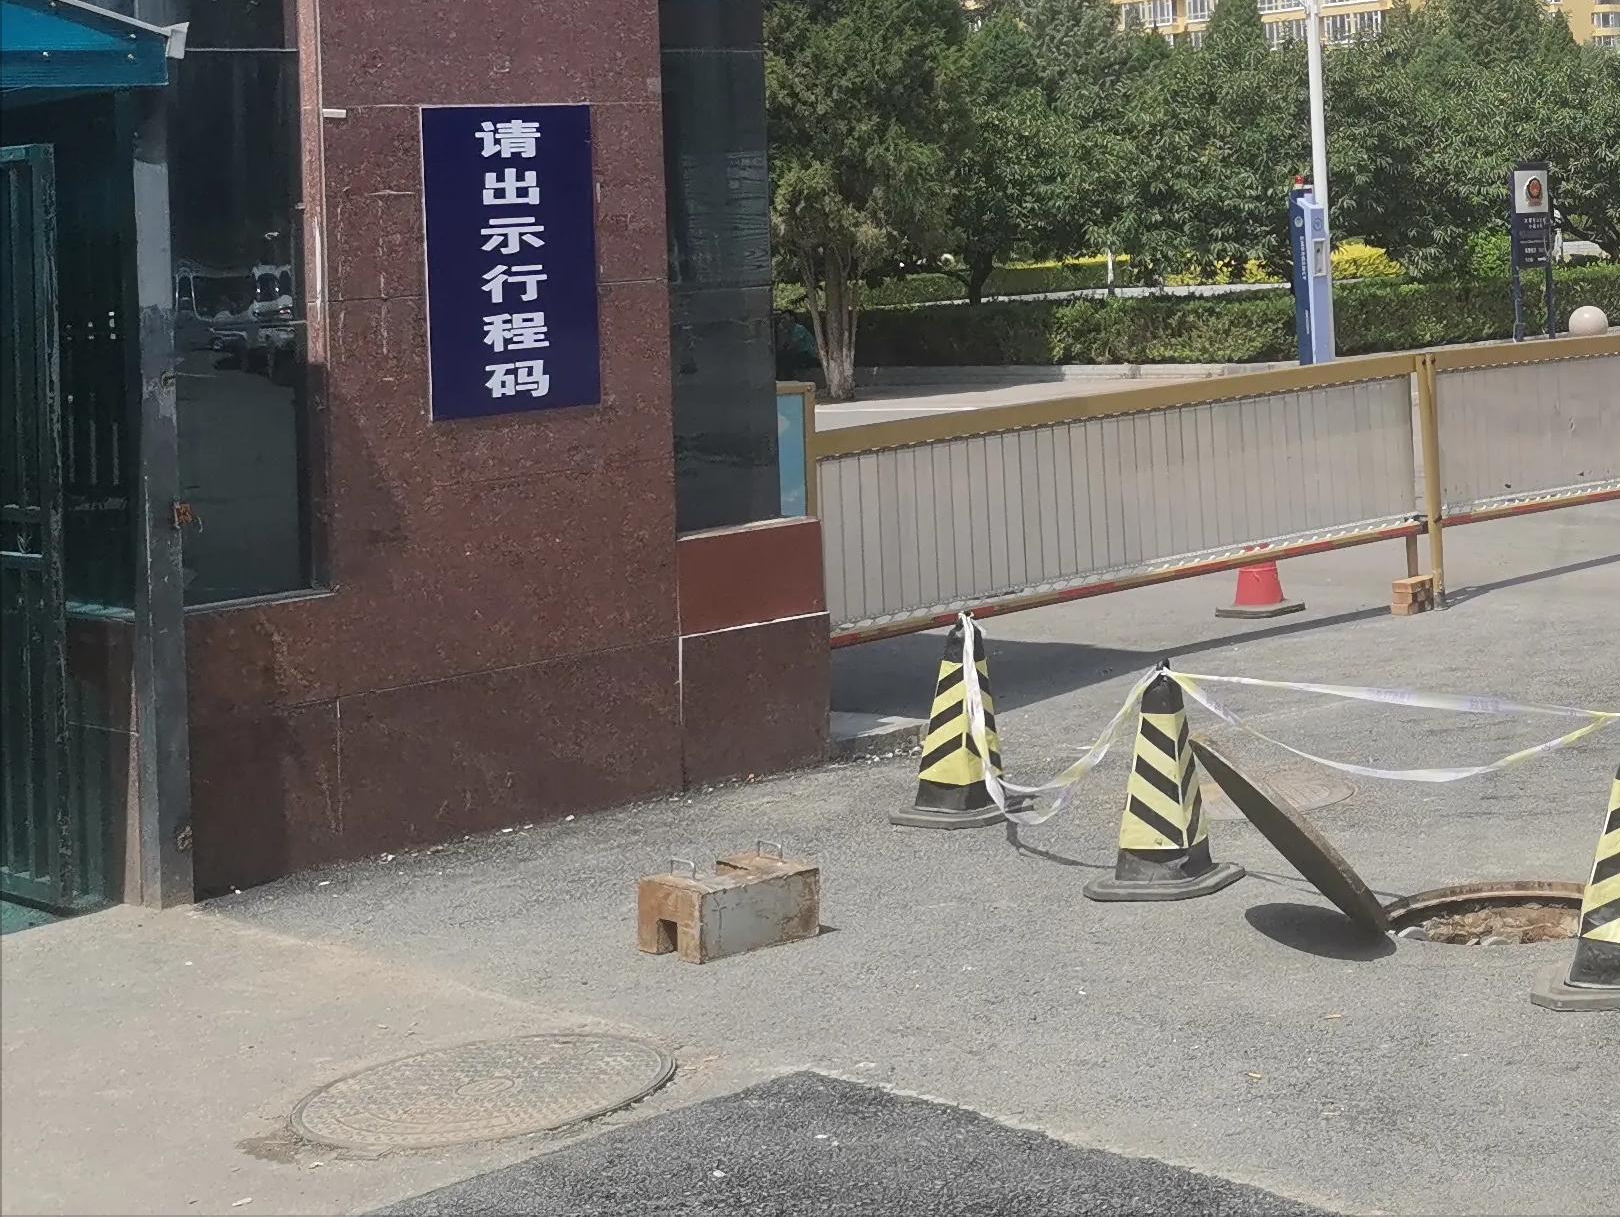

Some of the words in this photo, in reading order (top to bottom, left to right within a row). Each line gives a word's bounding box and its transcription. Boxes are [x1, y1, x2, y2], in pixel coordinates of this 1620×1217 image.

[474, 119, 550, 398] 请出示行程码
